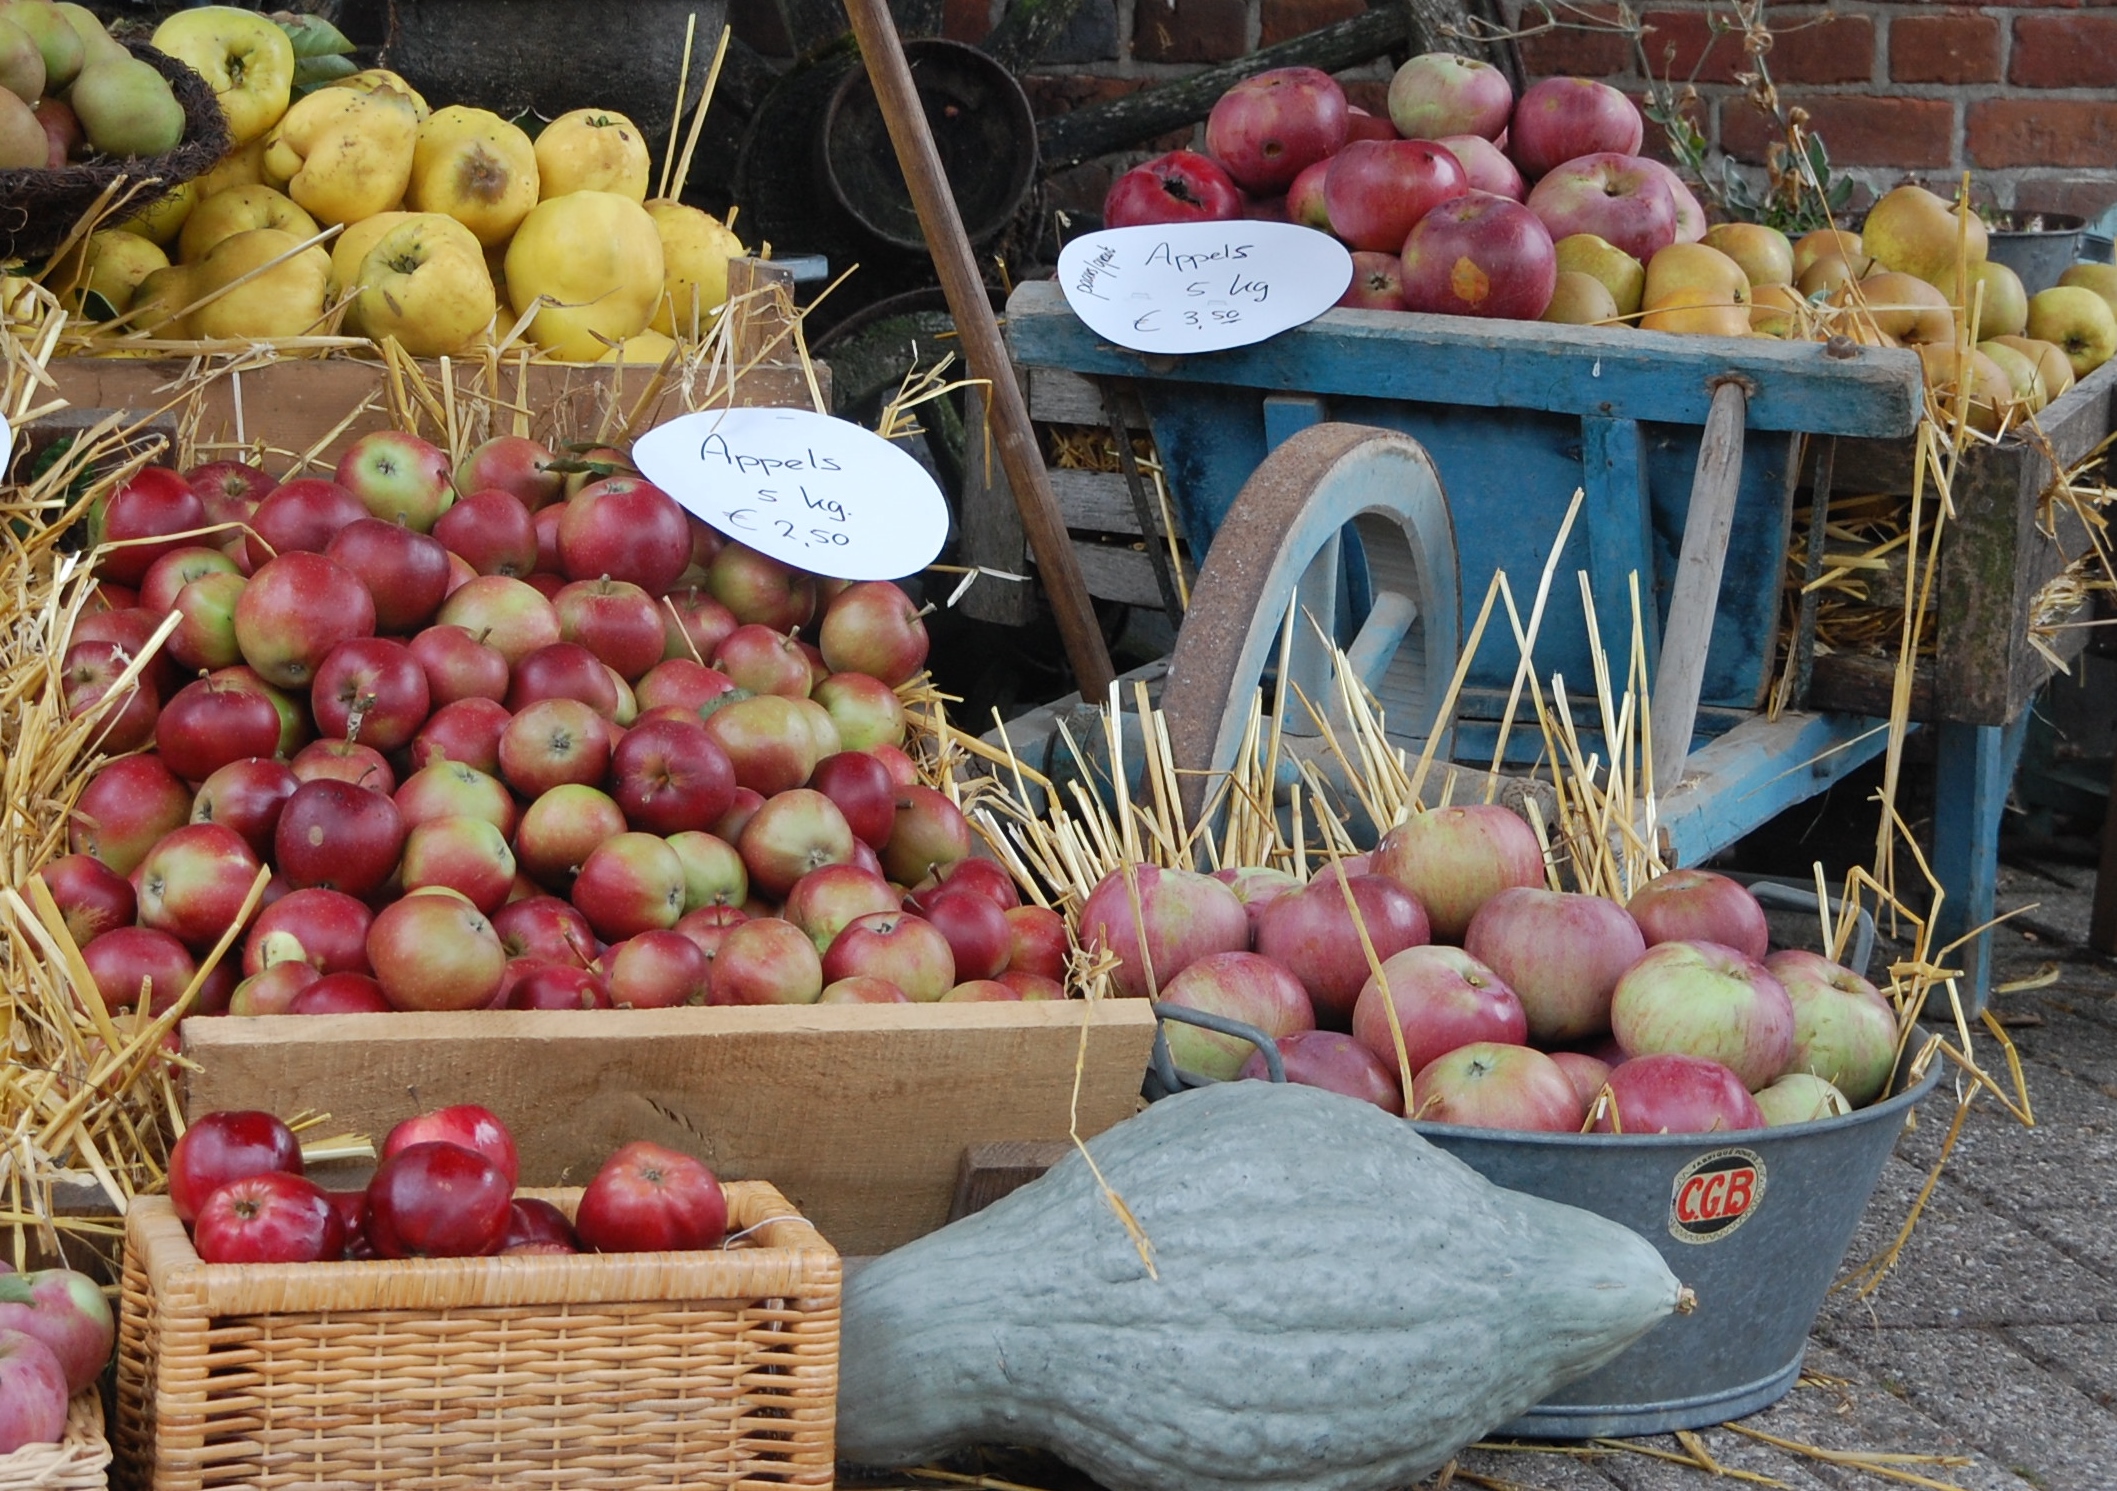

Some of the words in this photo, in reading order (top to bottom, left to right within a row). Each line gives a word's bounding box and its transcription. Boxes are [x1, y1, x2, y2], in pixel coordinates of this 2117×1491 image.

[1145, 242, 1255, 272] Appels
[1186, 281, 1210, 297] 5
[1229, 274, 1270, 303] kg
[1132, 309, 1162, 332] €
[700, 433, 842, 476] Appels
[757, 489, 778, 503] 5
[722, 508, 758, 531] €
